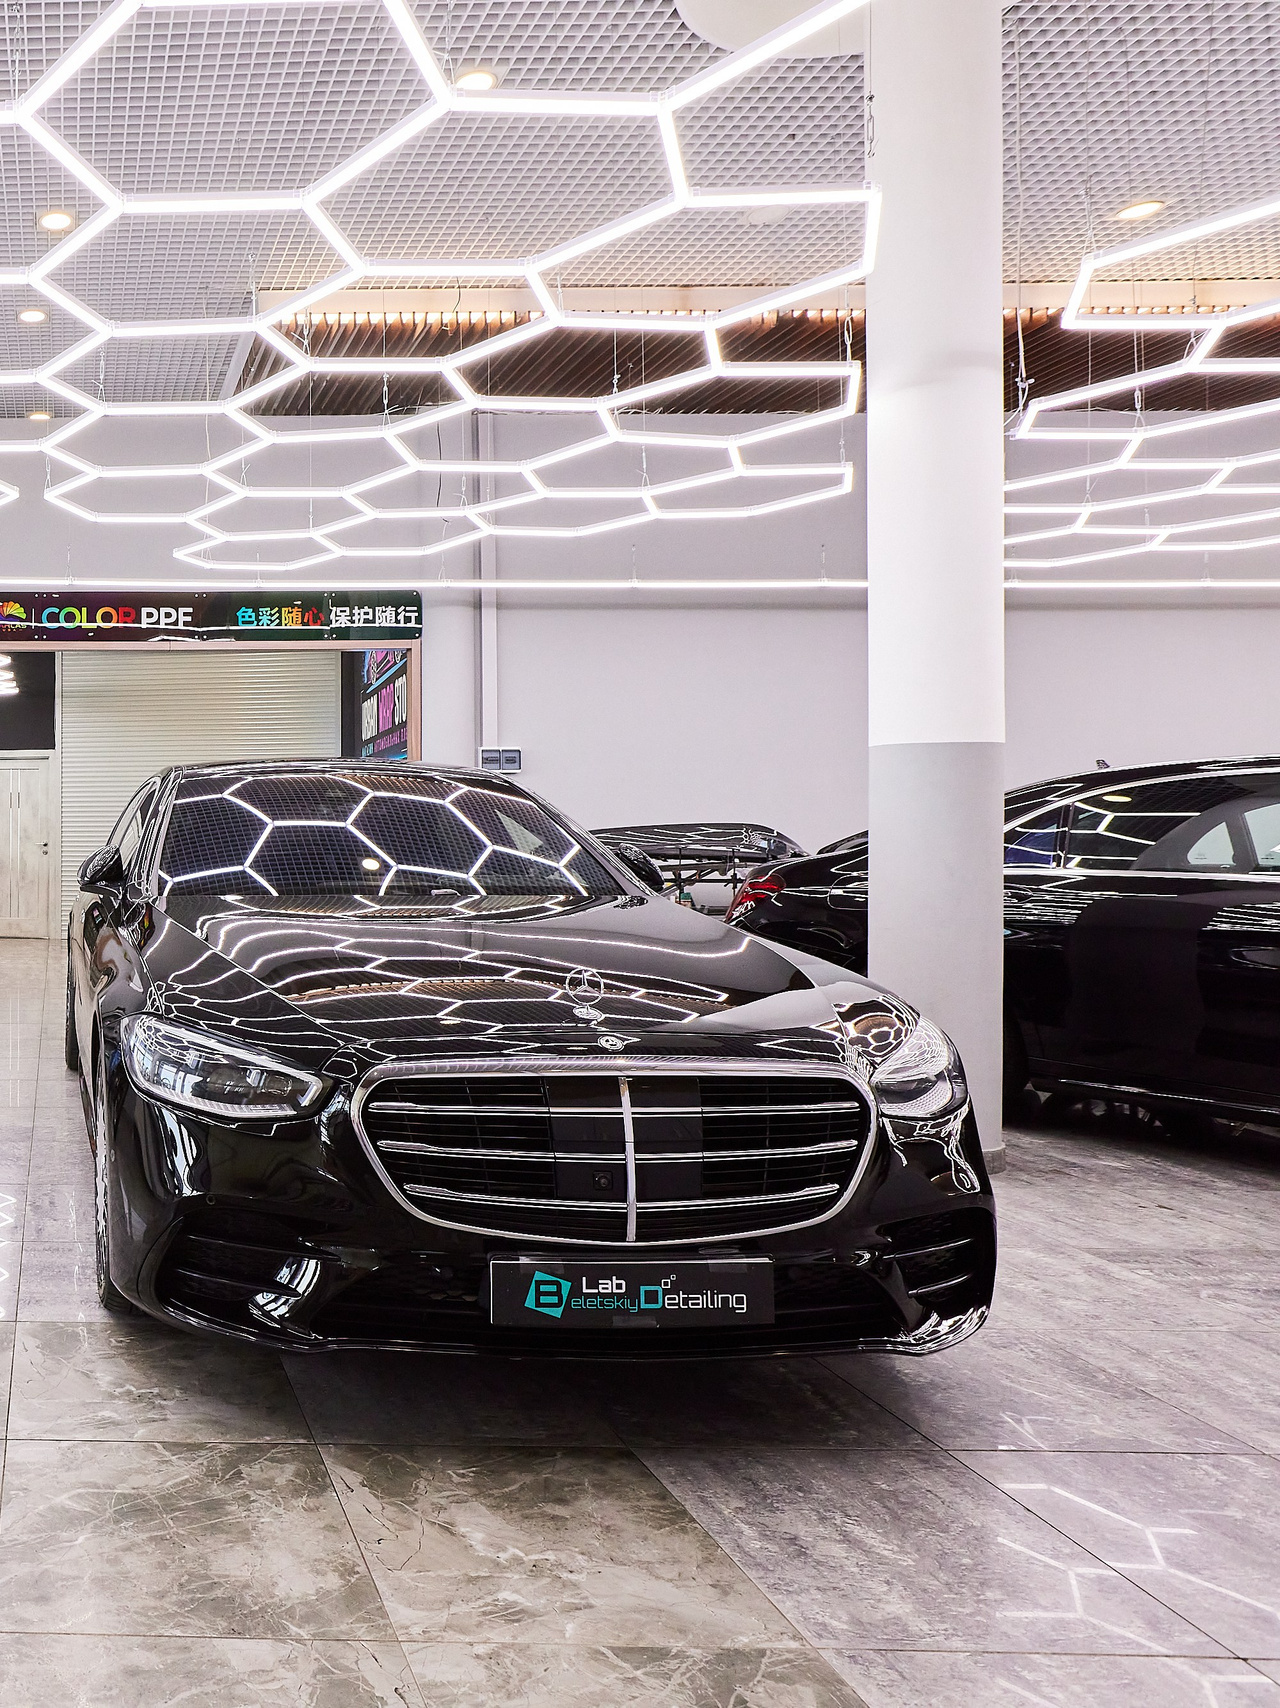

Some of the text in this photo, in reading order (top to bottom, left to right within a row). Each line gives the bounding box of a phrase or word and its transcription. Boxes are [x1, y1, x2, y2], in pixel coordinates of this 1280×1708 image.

[41, 606, 193, 629] COLOR PPF
[236, 605, 418, 627] 色彩随心 保护随行
[582, 1276, 626, 1294] Lab
[639, 1285, 747, 1313] Detailing
